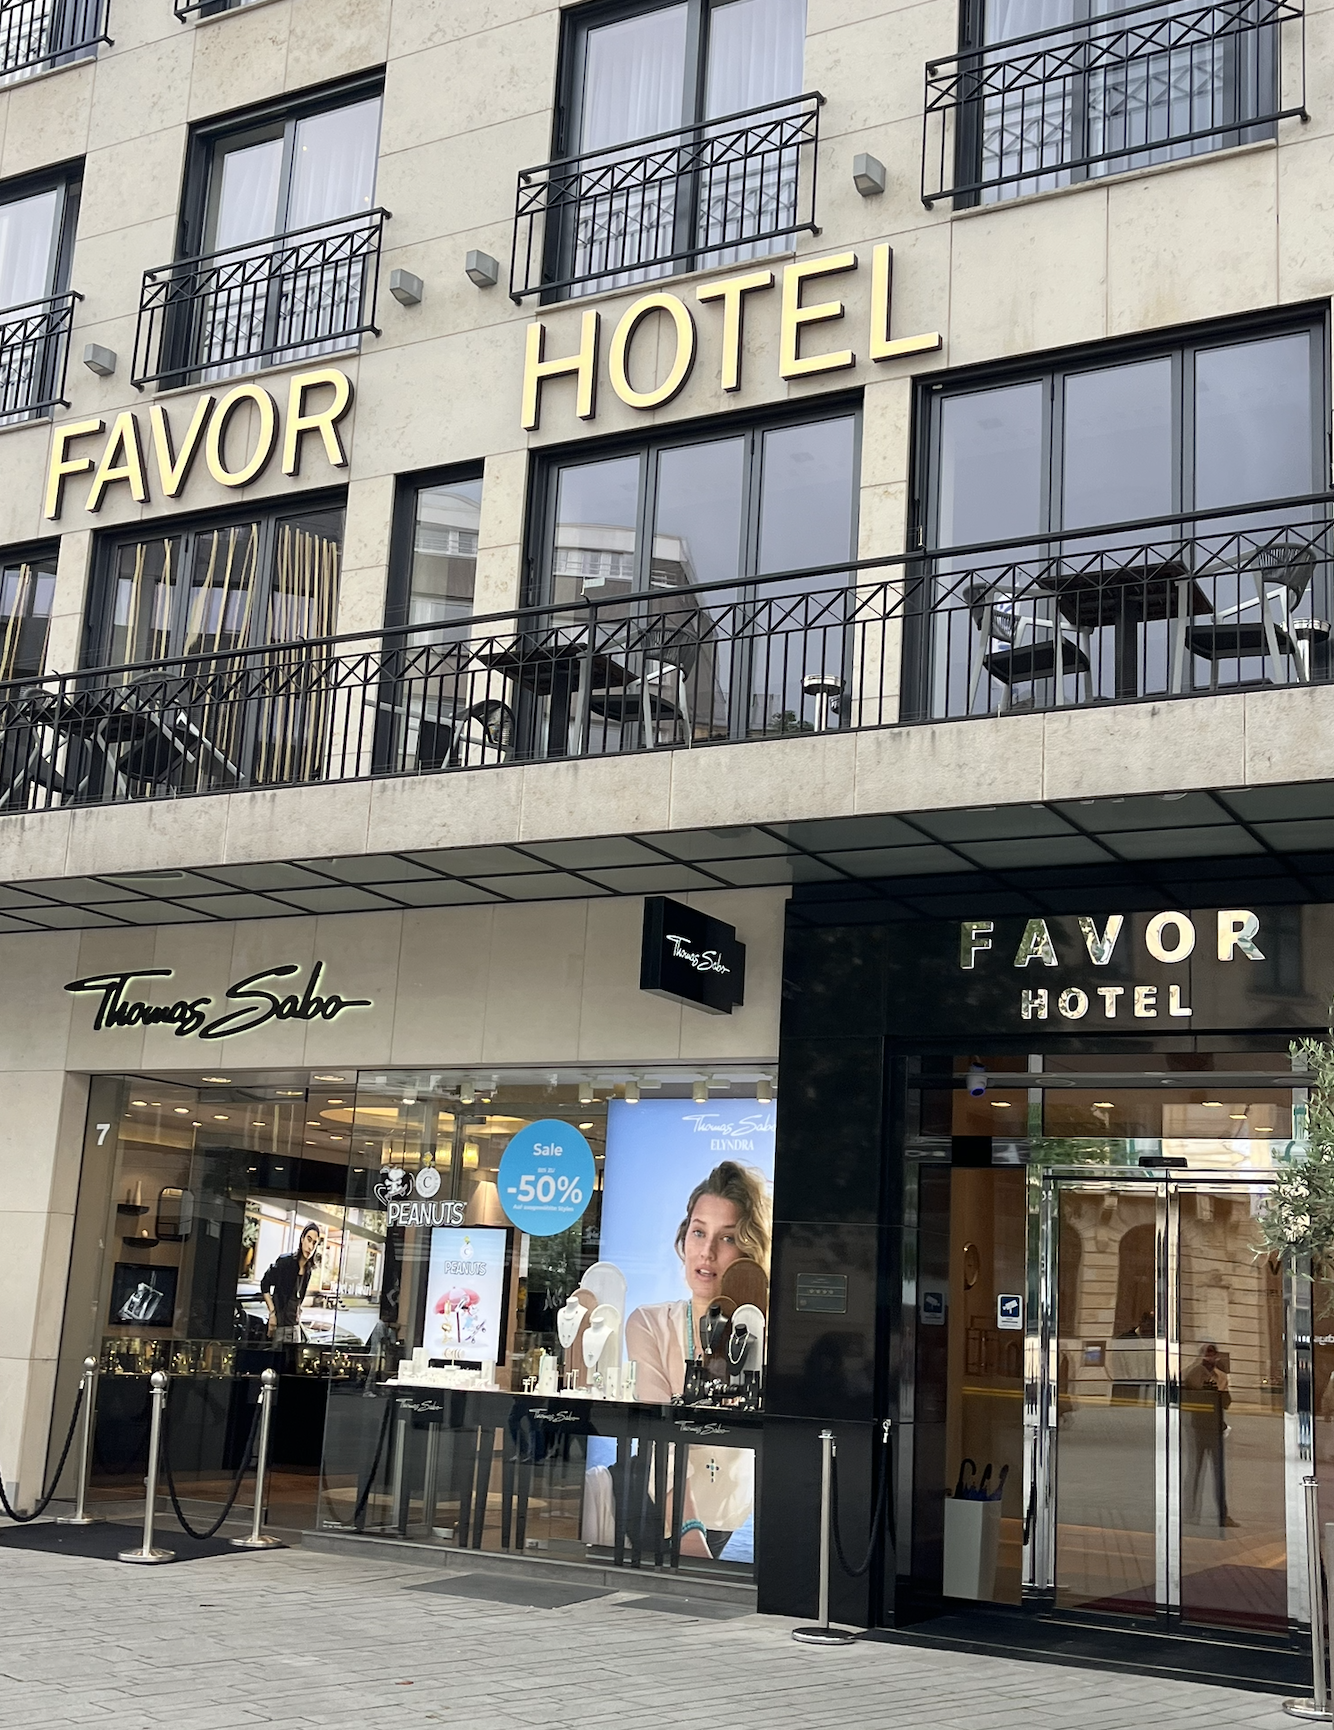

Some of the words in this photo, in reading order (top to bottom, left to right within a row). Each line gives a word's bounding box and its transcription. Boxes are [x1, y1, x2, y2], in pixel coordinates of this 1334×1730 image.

[44, 368, 354, 520] FAVOR
[520, 243, 942, 432] HOTEL
[959, 909, 1266, 970] FAVOR
[665, 934, 700, 967] Thomas
[696, 950, 731, 975] Sabo
[64, 967, 211, 1037] Thomas
[198, 961, 372, 1040] Sabo
[1020, 984, 1194, 1021] HOTEL
[95, 1123, 111, 1146] 7
[682, 1113, 735, 1136] Thomas
[533, 1143, 563, 1156] Sale
[710, 1138, 755, 1151] ELYNDRA
[507, 1175, 583, 1204] -50%
[388, 1200, 464, 1227] PEANUTS
[443, 1260, 487, 1277] PEANUTS
